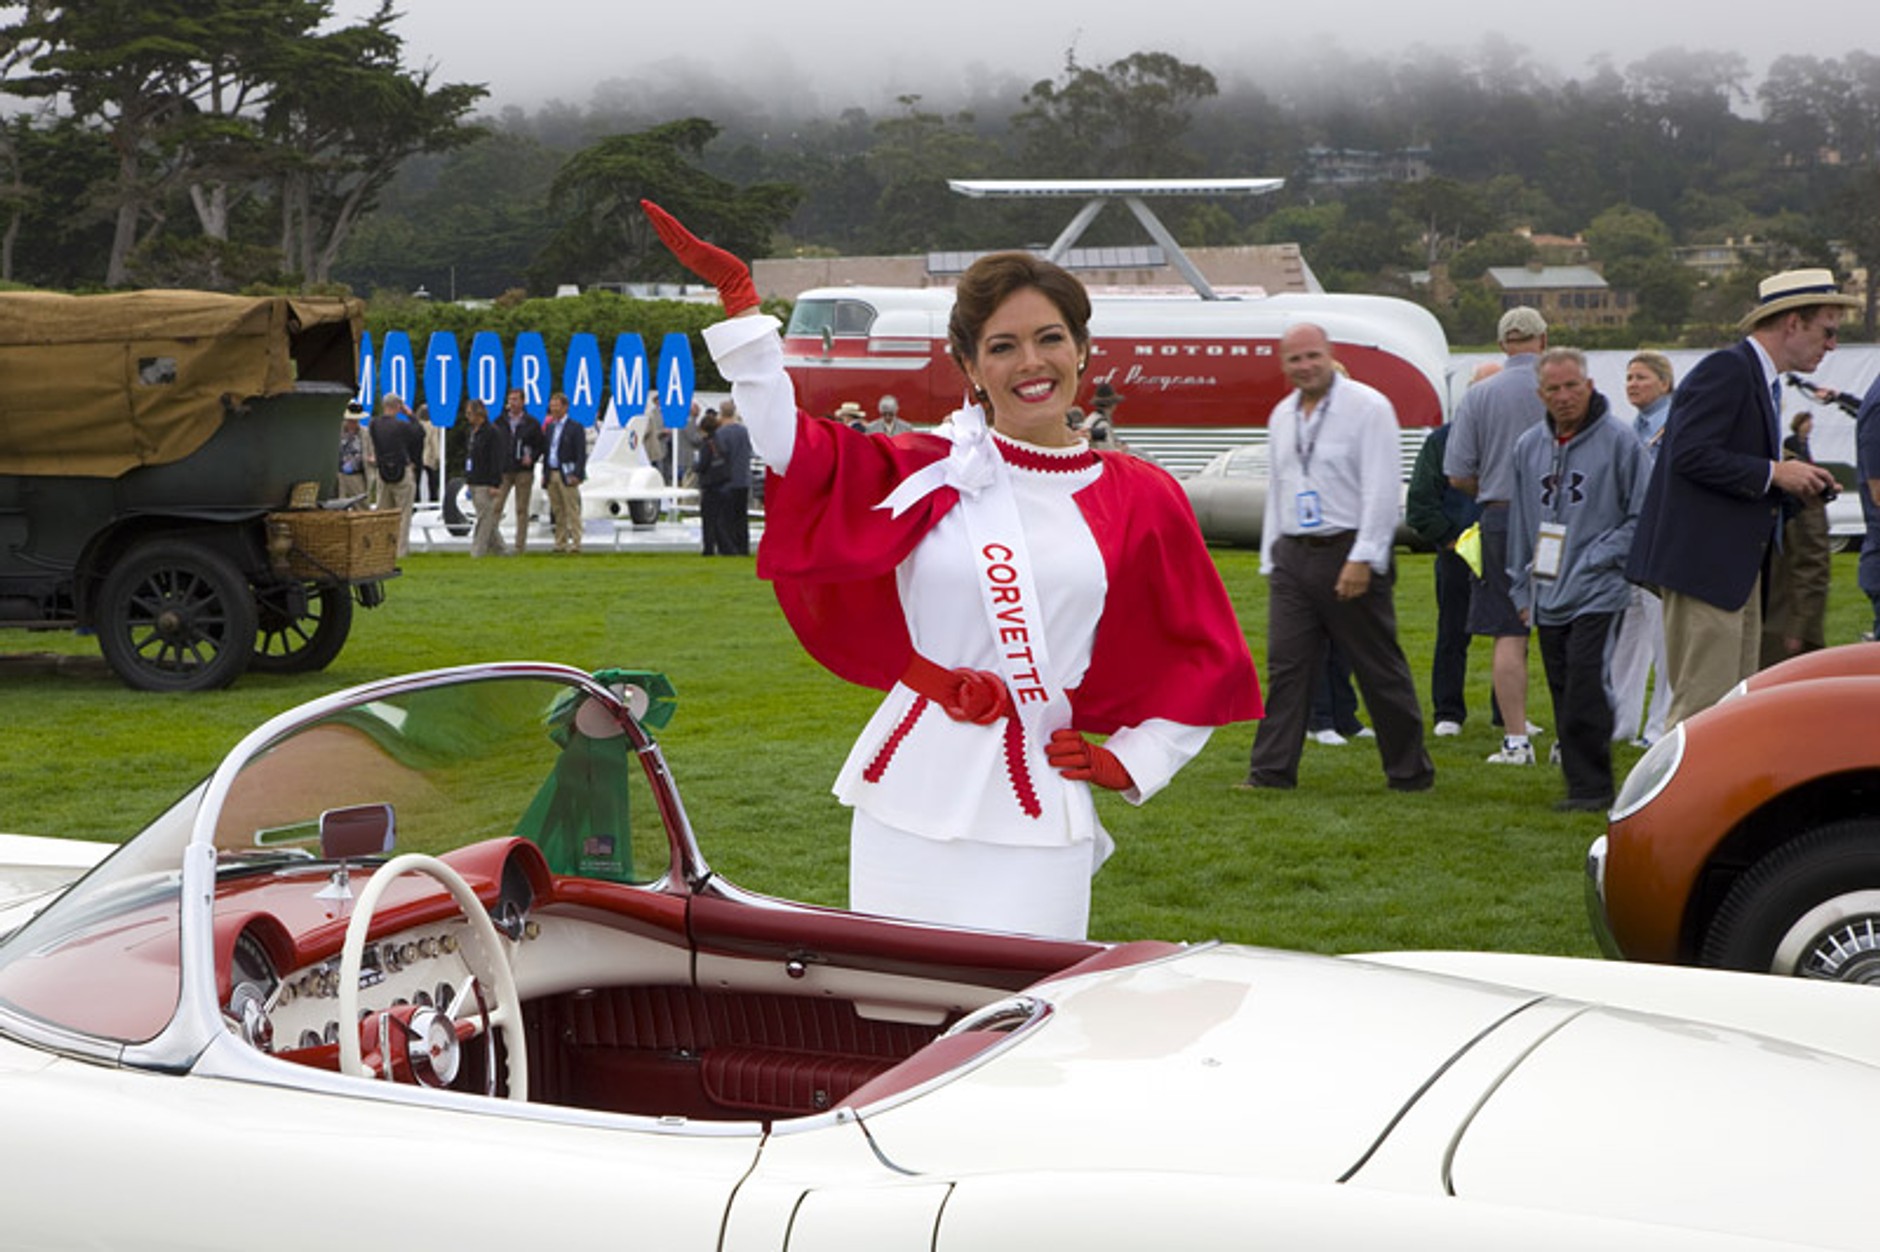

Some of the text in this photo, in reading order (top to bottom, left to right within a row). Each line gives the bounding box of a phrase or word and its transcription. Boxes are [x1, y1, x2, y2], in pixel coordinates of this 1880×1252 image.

[1134, 344, 1273, 356] MOTORS
[1092, 364, 1217, 391] of Progress
[982, 543, 1049, 705] CORVETTE
